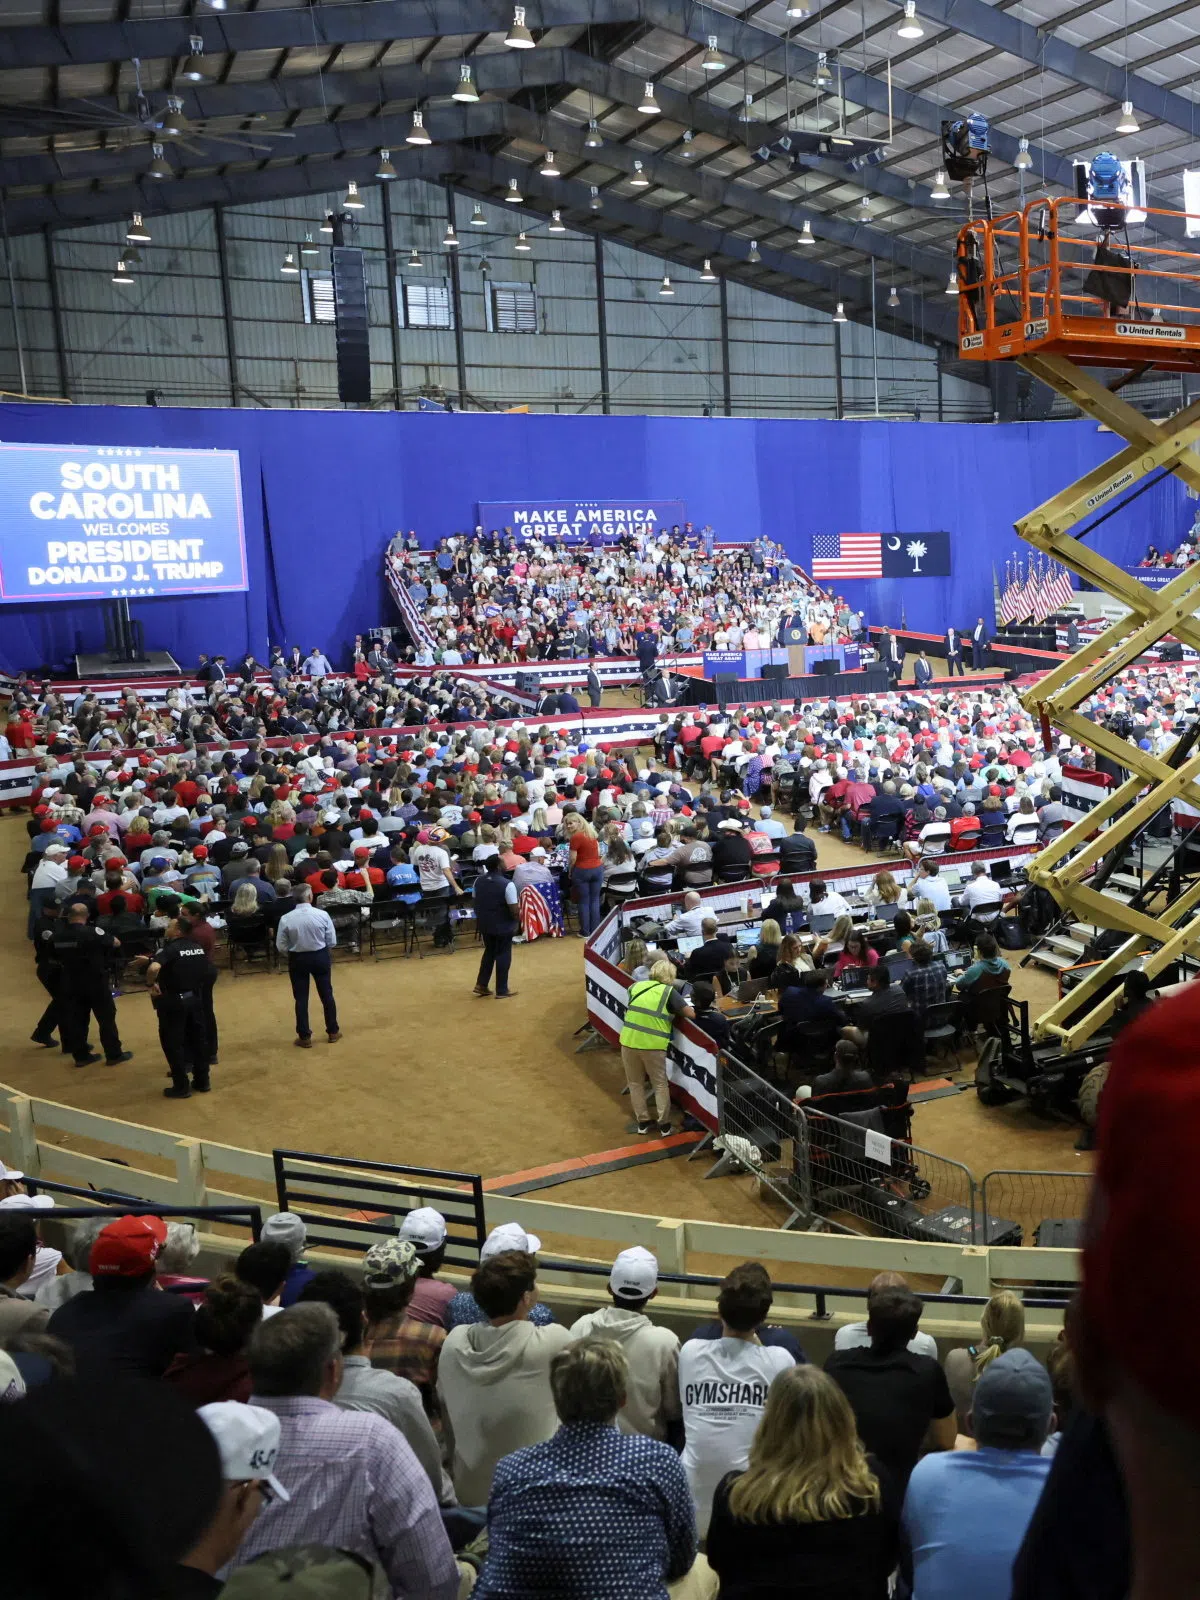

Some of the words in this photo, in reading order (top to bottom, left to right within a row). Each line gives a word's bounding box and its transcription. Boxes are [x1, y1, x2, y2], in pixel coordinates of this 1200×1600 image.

[1129, 326, 1154, 335] United
[1156, 328, 1182, 338] Rentals
[60, 461, 180, 491] SOUTH
[1094, 487, 1113, 502] United
[1113, 473, 1133, 490] Rentals
[29, 491, 212, 520] CAROLINA
[514, 510, 567, 523] MAKE
[574, 509, 658, 523] AMERICA
[82, 522, 170, 536] WELCOMES
[521, 523, 582, 537] GREAT
[47, 538, 204, 564] PRESIDENT
[27, 564, 127, 585] DONALD
[131, 564, 149, 581] J.
[152, 561, 224, 581] TRUMP
[179, 948, 205, 957] POLICE
